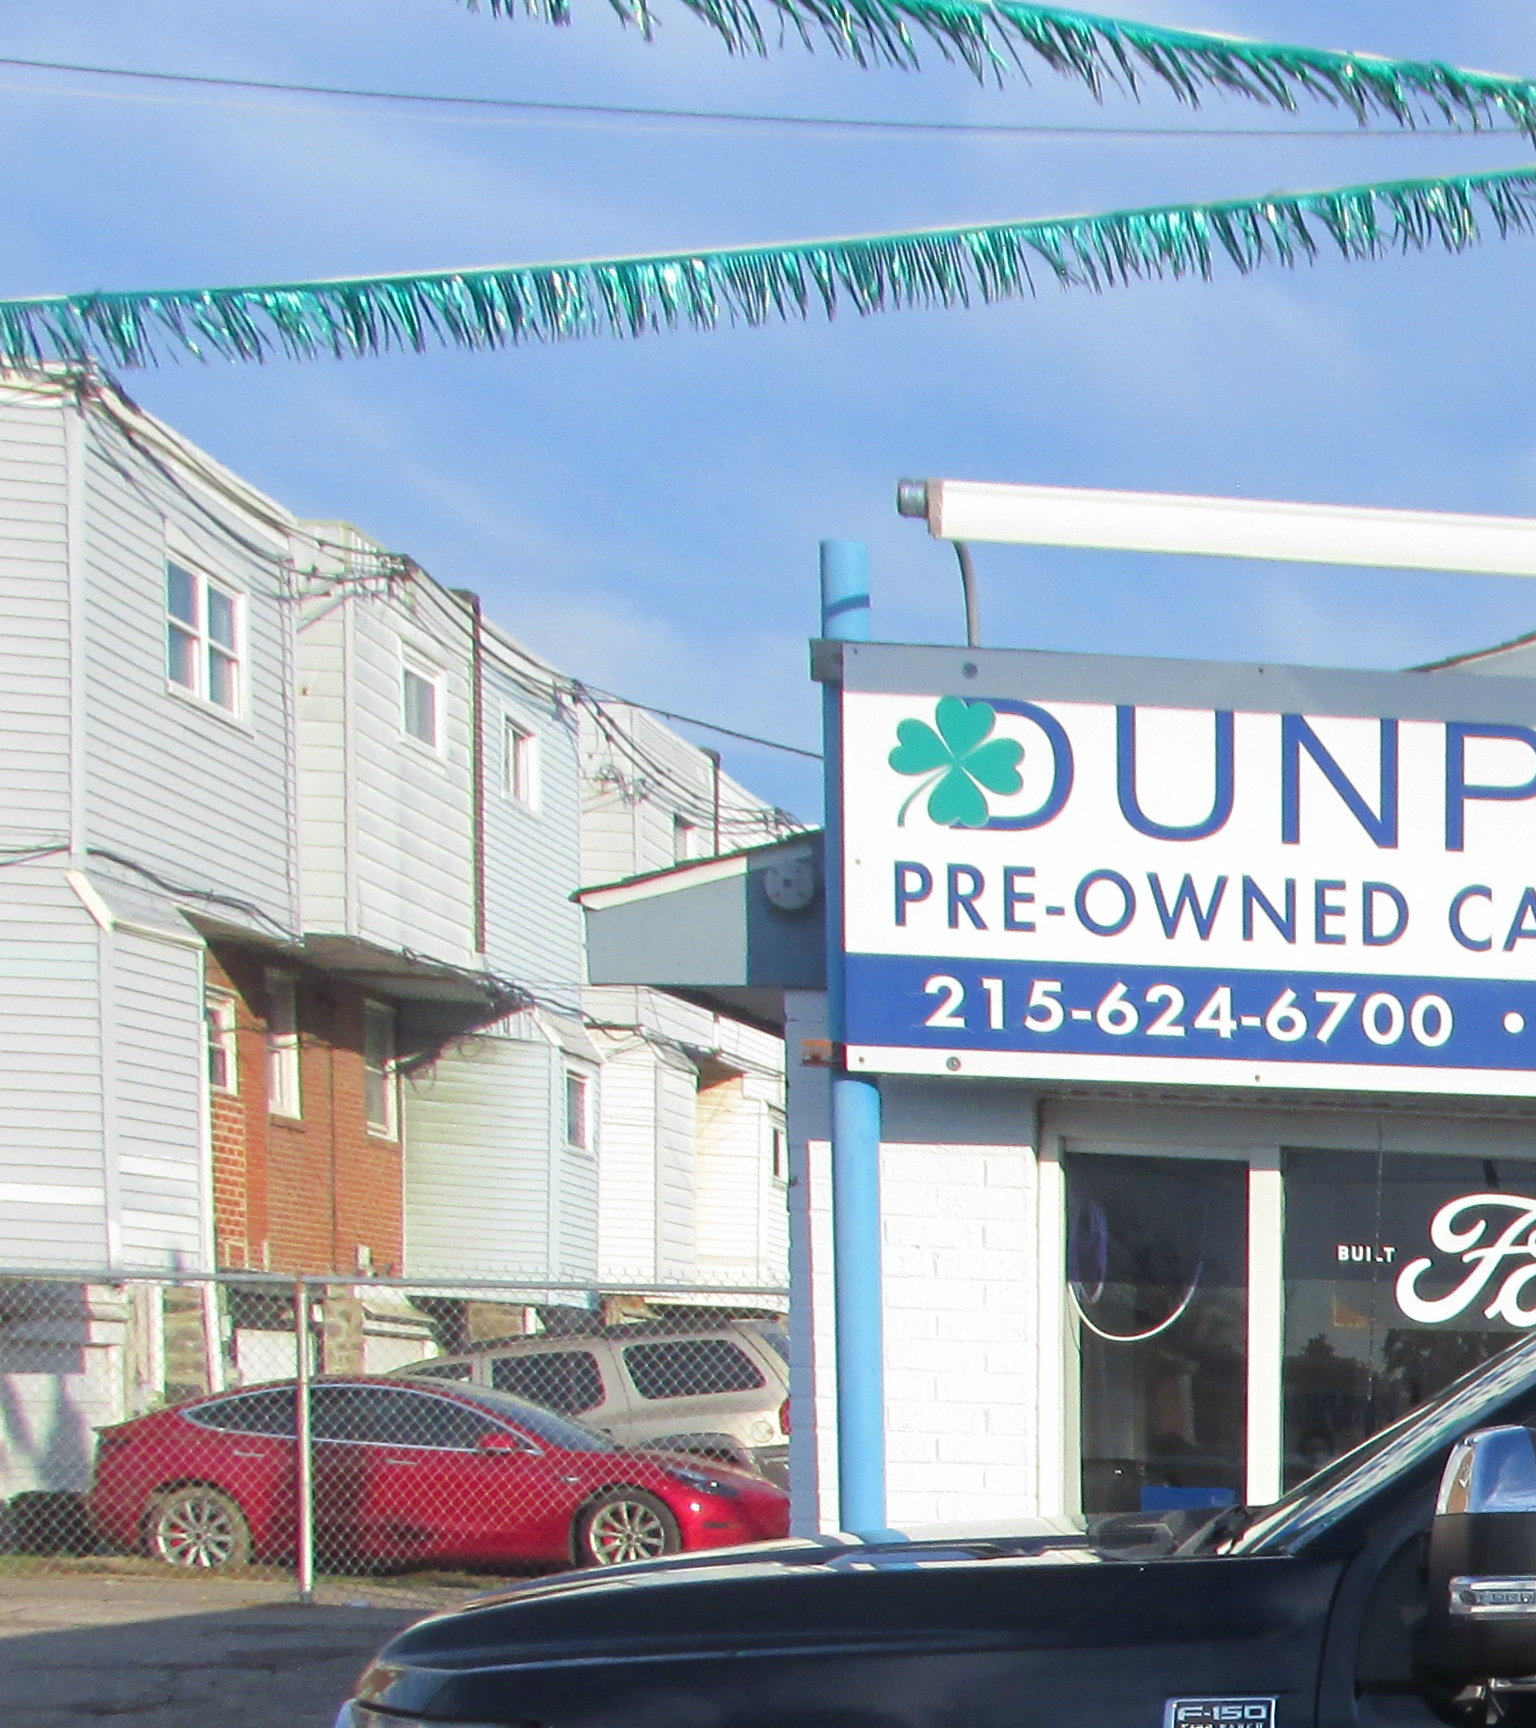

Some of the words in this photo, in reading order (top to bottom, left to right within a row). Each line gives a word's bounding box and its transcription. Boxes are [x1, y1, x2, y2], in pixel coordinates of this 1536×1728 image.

[893, 860, 1410, 947] PRE-OWNED
[923, 975, 1454, 1048] 215-624-6700
[1177, 1705, 1267, 1721] F-150
